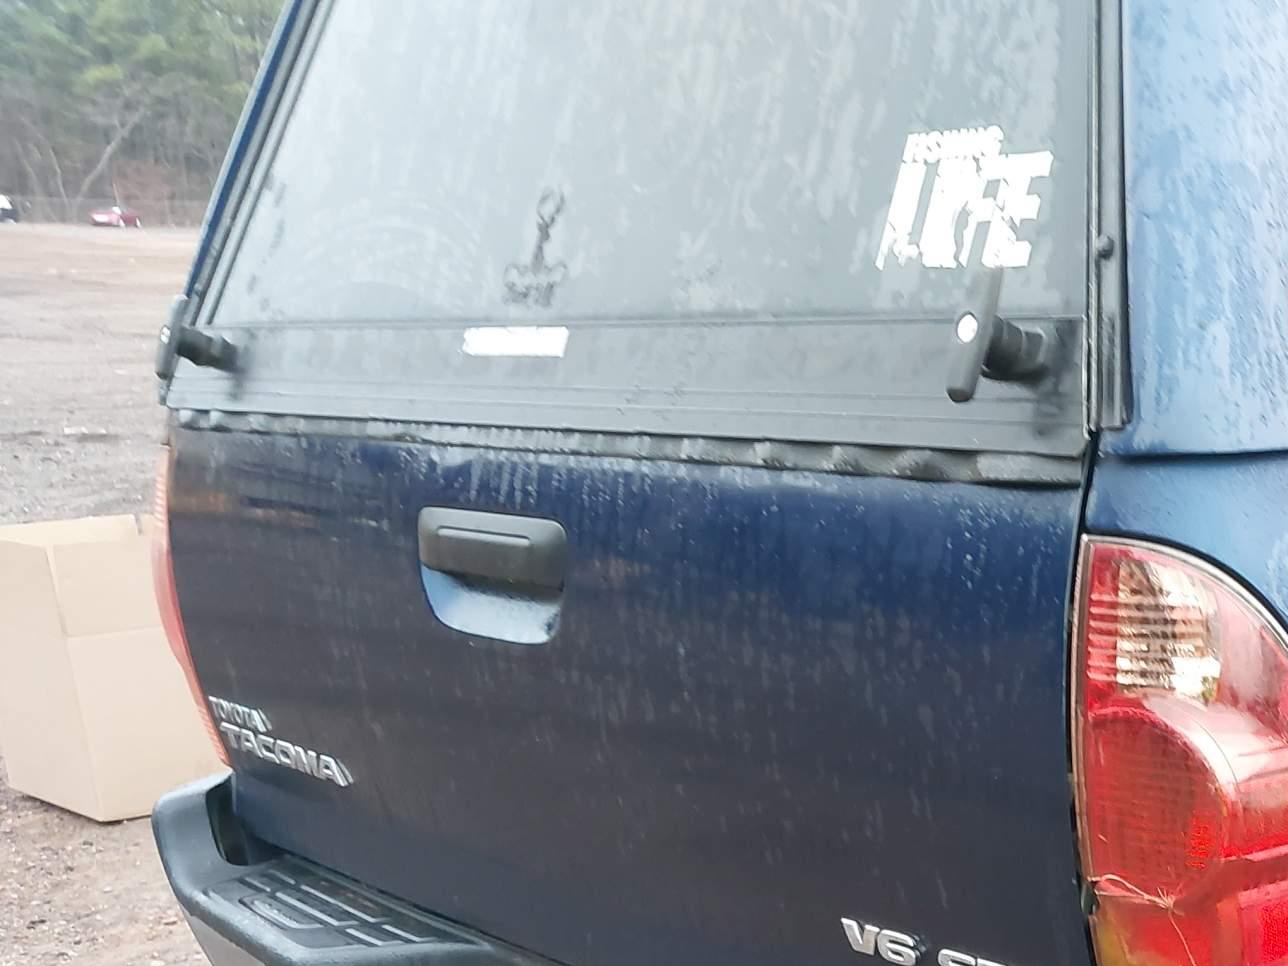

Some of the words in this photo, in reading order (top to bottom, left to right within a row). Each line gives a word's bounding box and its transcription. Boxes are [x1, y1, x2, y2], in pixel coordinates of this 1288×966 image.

[208, 695, 271, 733] TOYOTA
[219, 721, 353, 787] TACOMA
[840, 916, 918, 966] V6
